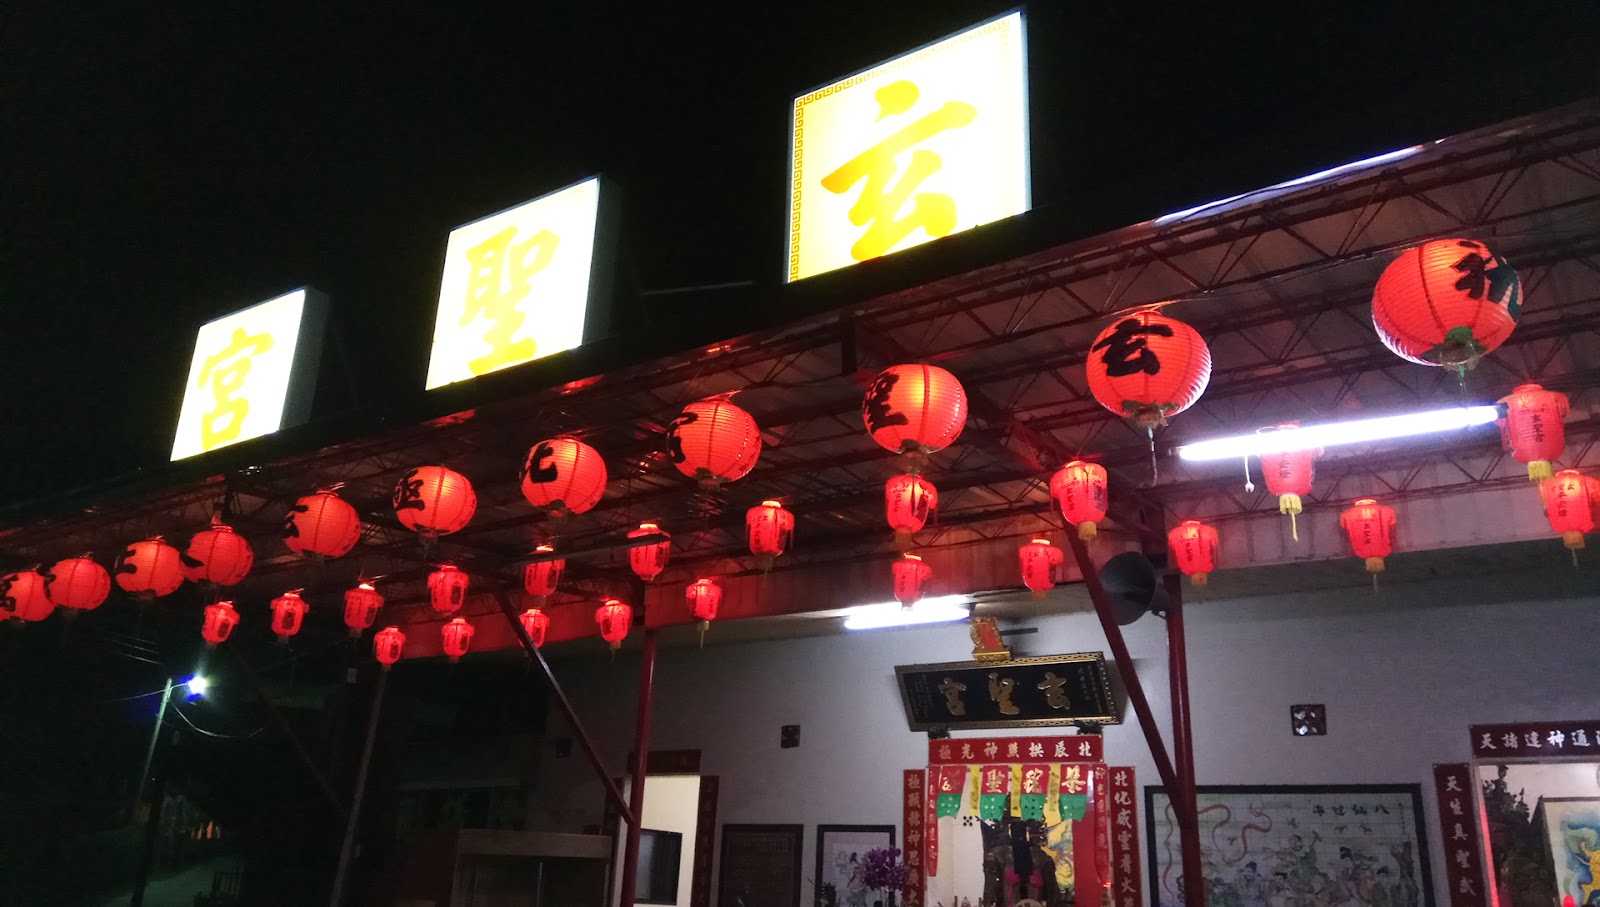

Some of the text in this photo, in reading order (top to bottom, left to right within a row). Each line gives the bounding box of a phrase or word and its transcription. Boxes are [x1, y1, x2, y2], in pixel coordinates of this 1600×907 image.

[821, 80, 977, 264] 玄
[458, 225, 561, 377] 聖
[1092, 319, 1173, 377] 玄
[197, 328, 275, 452] 宮
